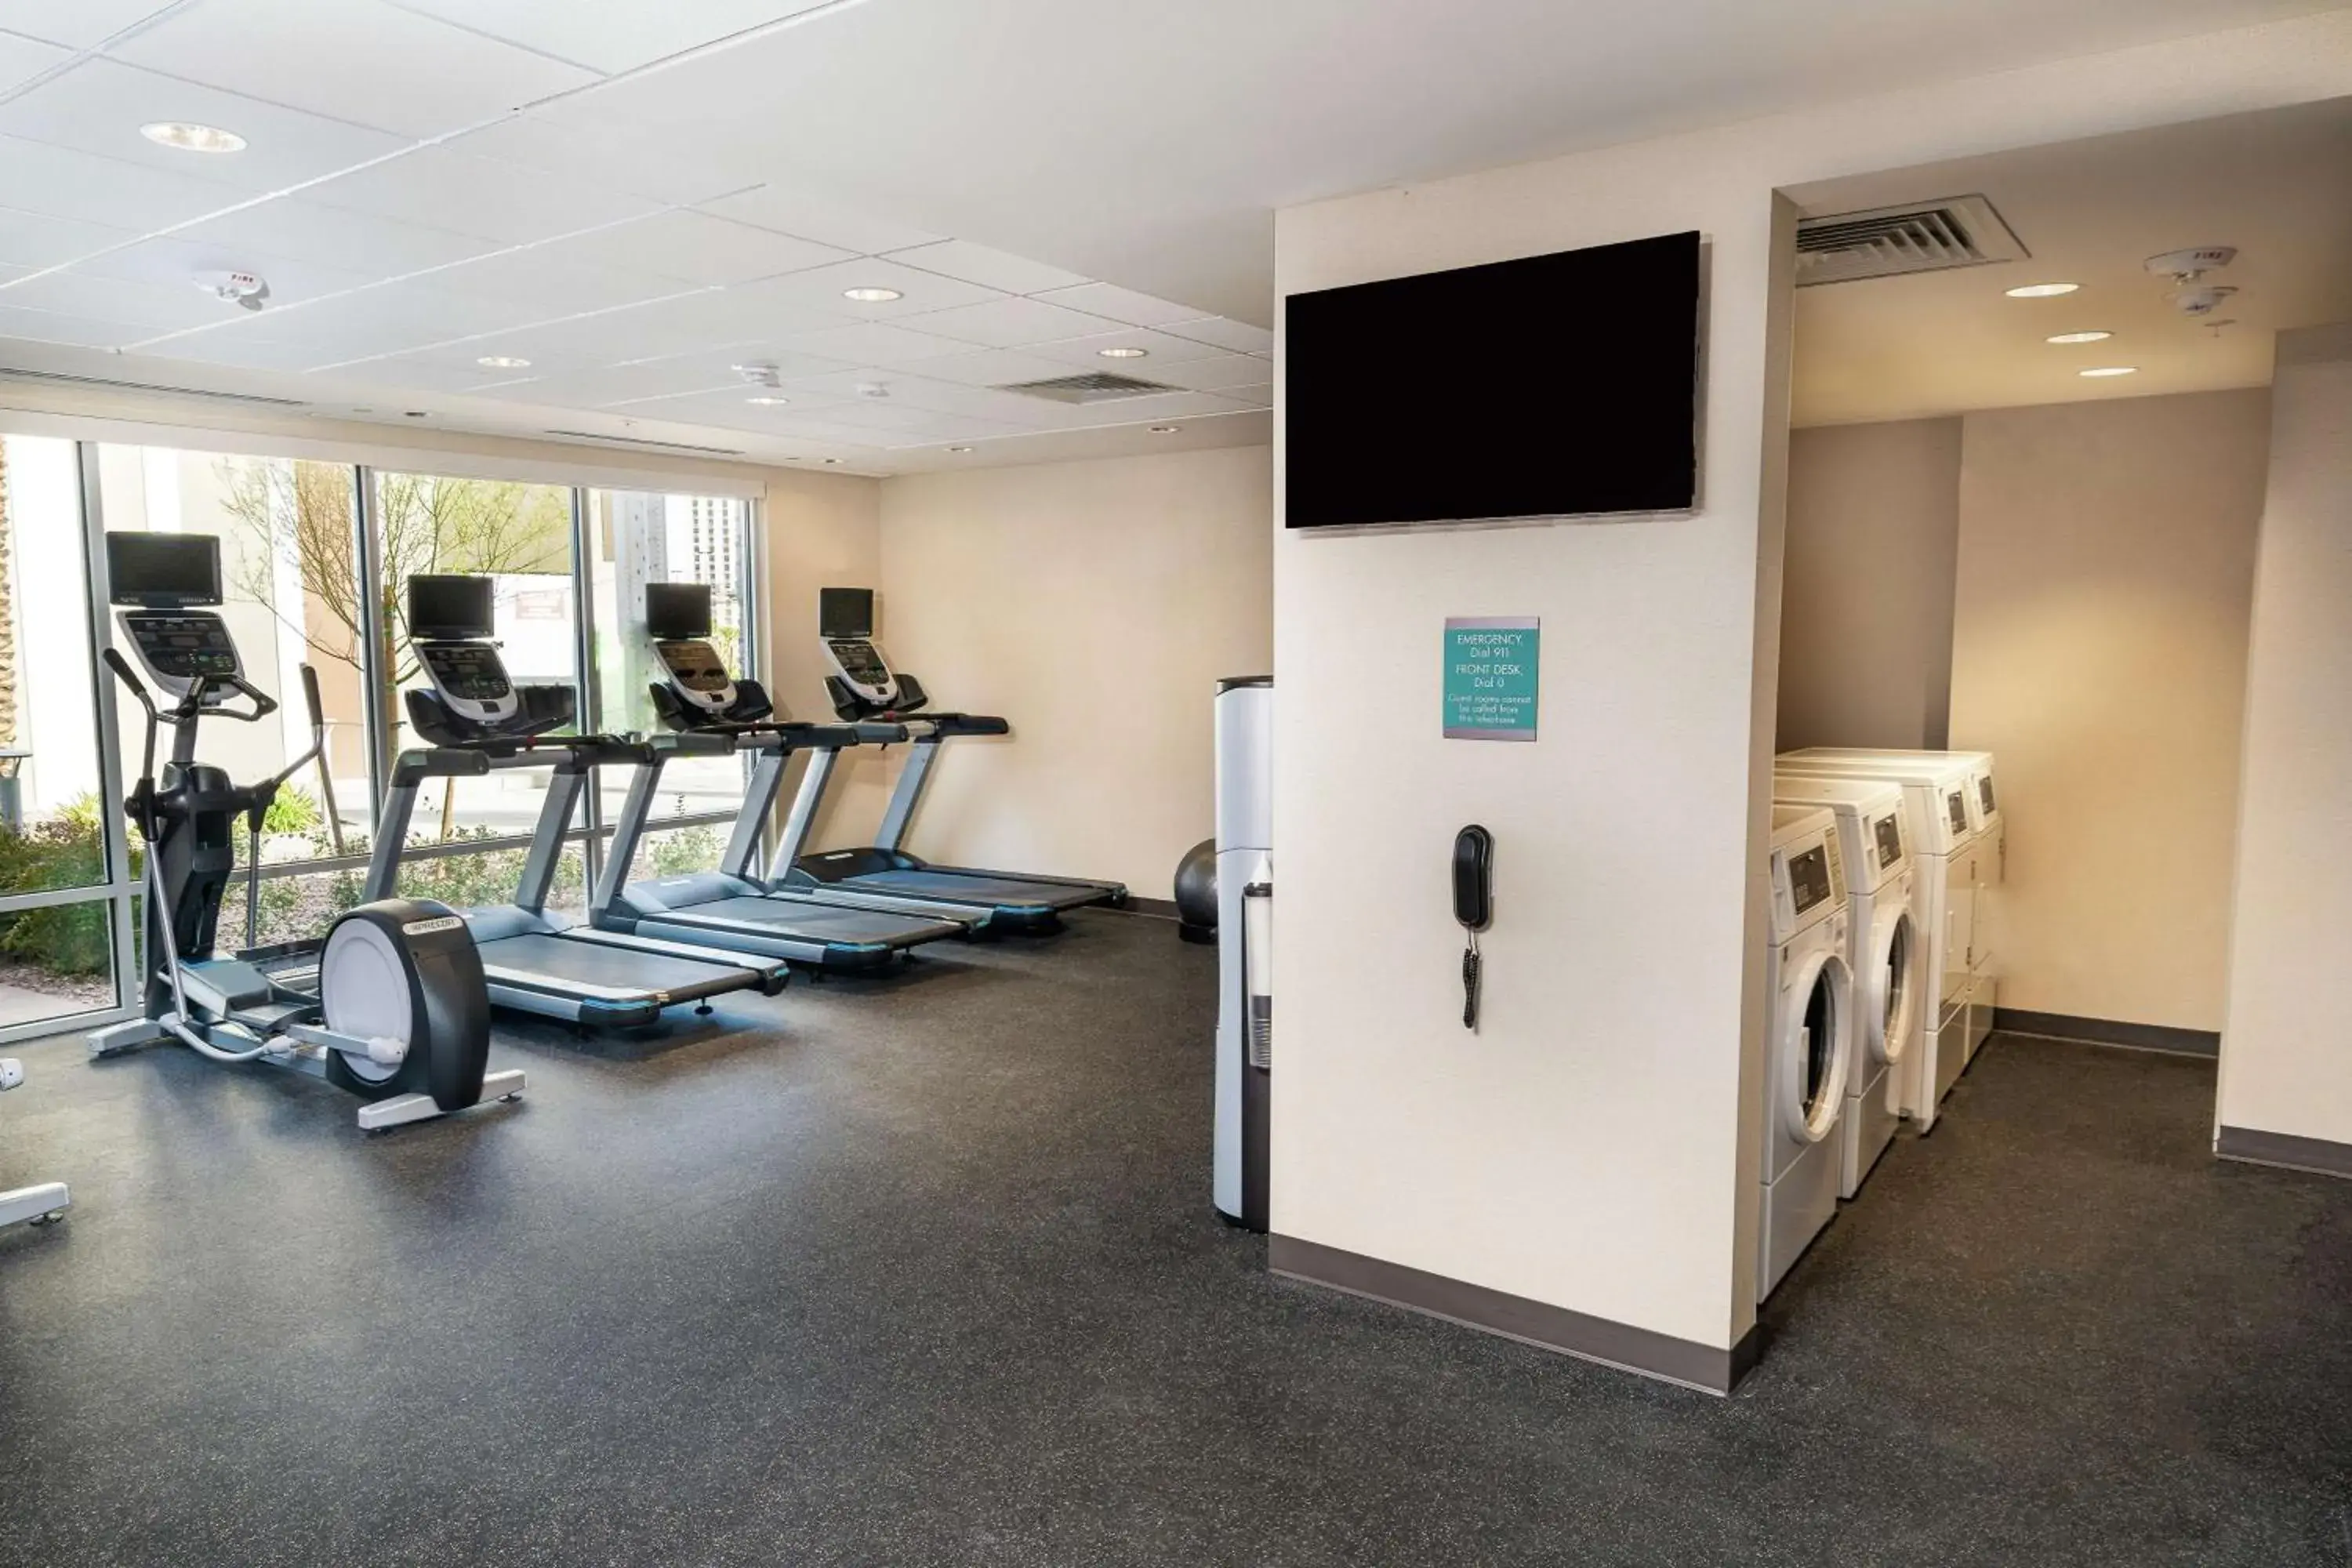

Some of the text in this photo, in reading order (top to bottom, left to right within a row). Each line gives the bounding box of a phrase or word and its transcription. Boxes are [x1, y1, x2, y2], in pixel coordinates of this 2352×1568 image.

[1470, 646, 1510, 659] Dial 911
[1456, 664, 1490, 675] FRONT
[1475, 677, 1505, 688] Dial 0
